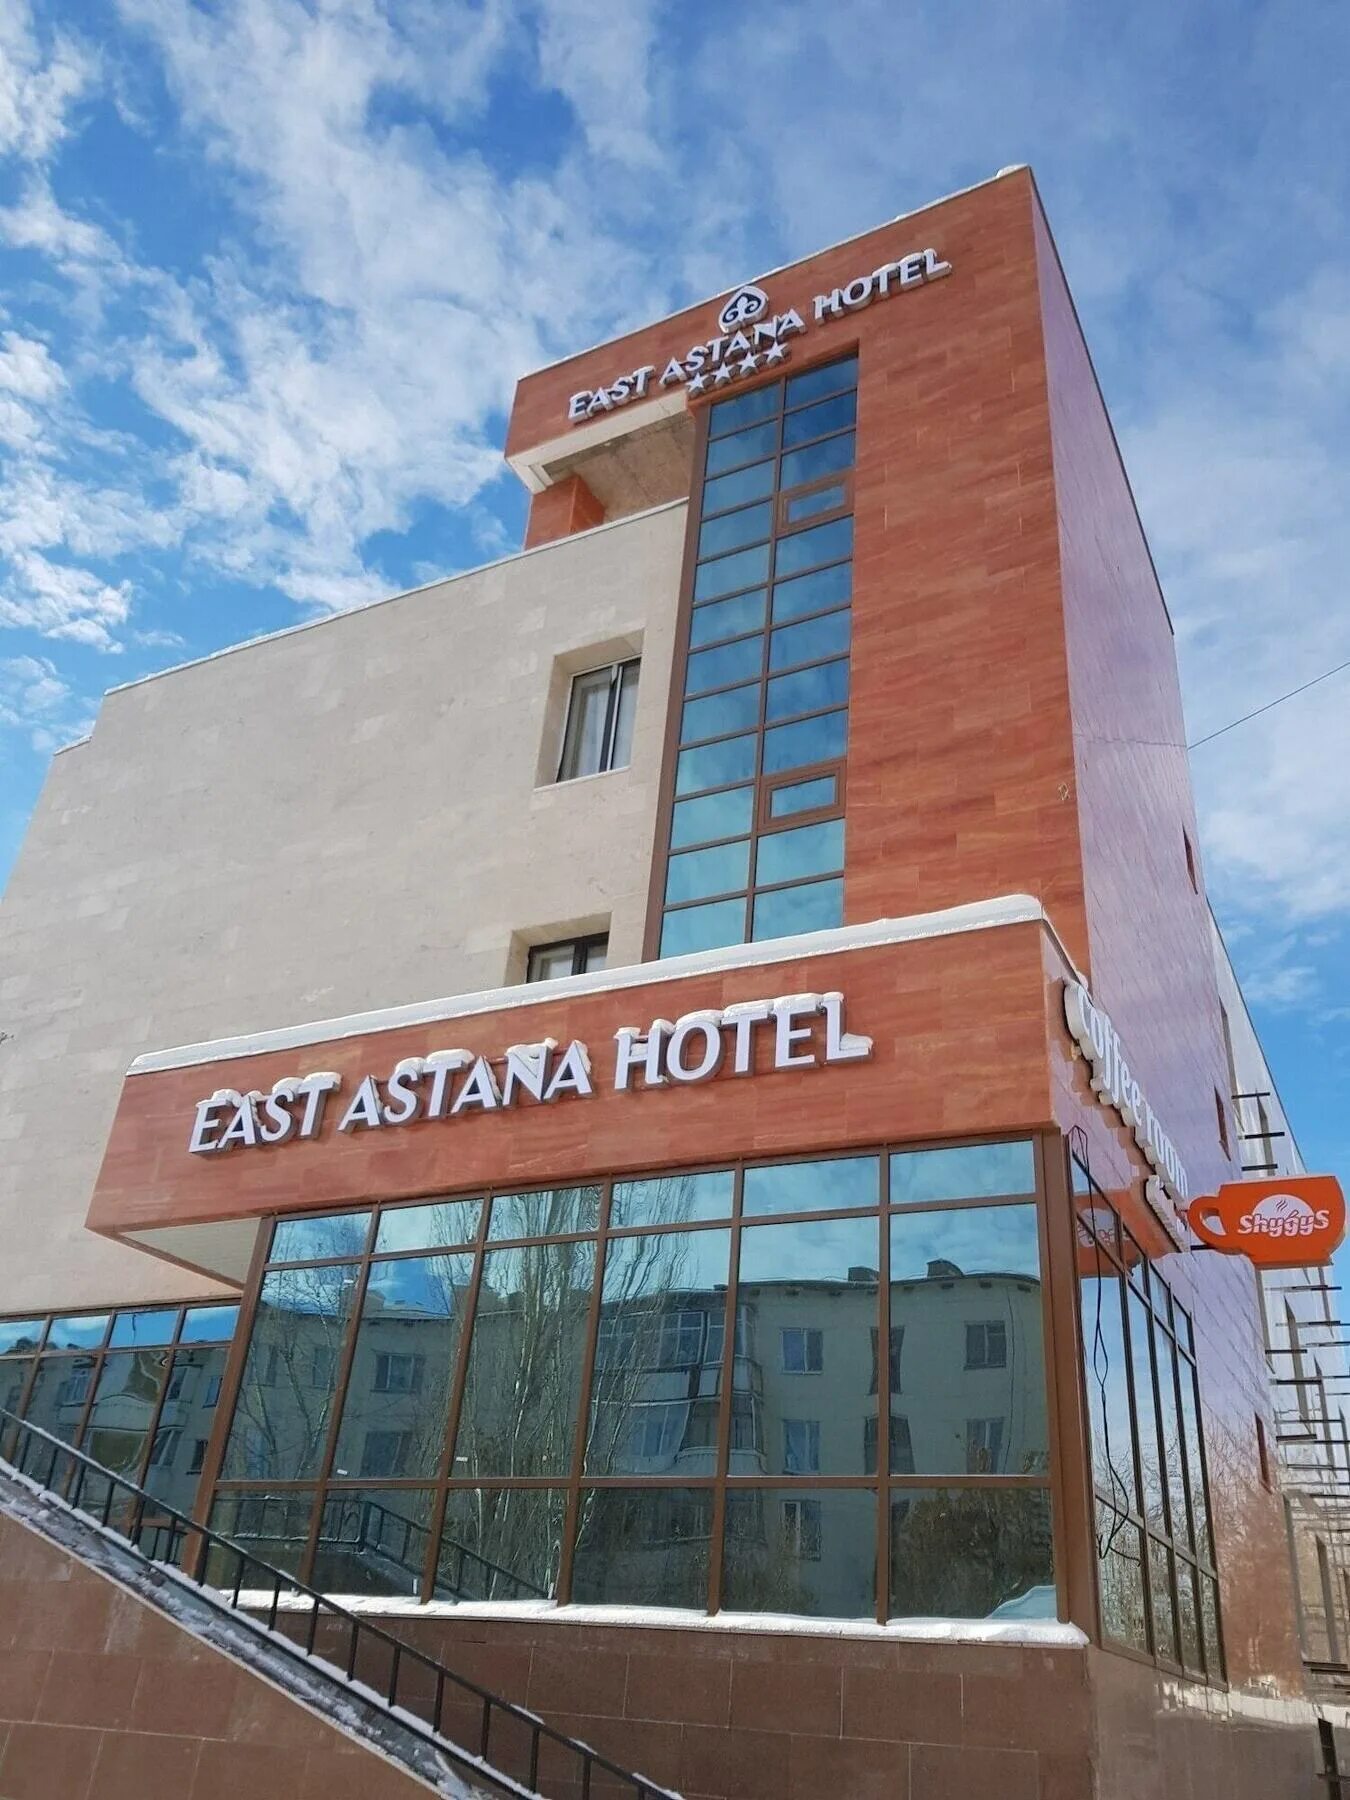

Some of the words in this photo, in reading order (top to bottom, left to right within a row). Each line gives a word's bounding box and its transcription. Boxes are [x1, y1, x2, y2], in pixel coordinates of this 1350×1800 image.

[568, 365, 655, 423] EAST
[659, 308, 807, 388] ASTANA
[813, 247, 952, 325] HOTEL
[189, 1072, 341, 1155] EAST
[338, 1040, 594, 1131] ASTANA
[614, 991, 873, 1090] HOTEL
